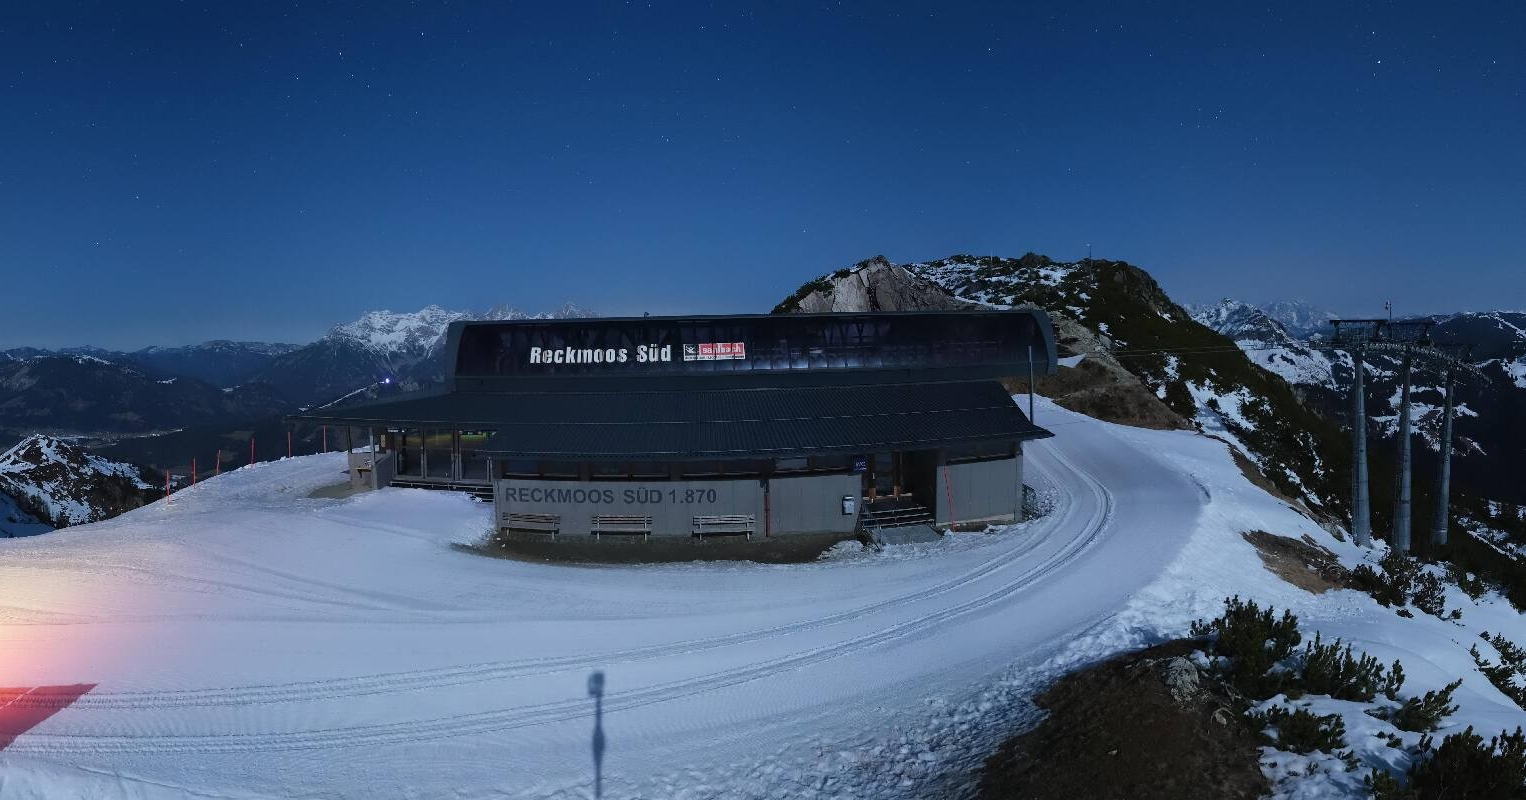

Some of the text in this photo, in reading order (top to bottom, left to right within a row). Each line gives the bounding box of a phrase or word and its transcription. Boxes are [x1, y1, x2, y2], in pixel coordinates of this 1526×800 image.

[529, 344, 672, 364] Reckmoos Süd
[505, 487, 717, 505] RECKMOOS SÜD 1.870
